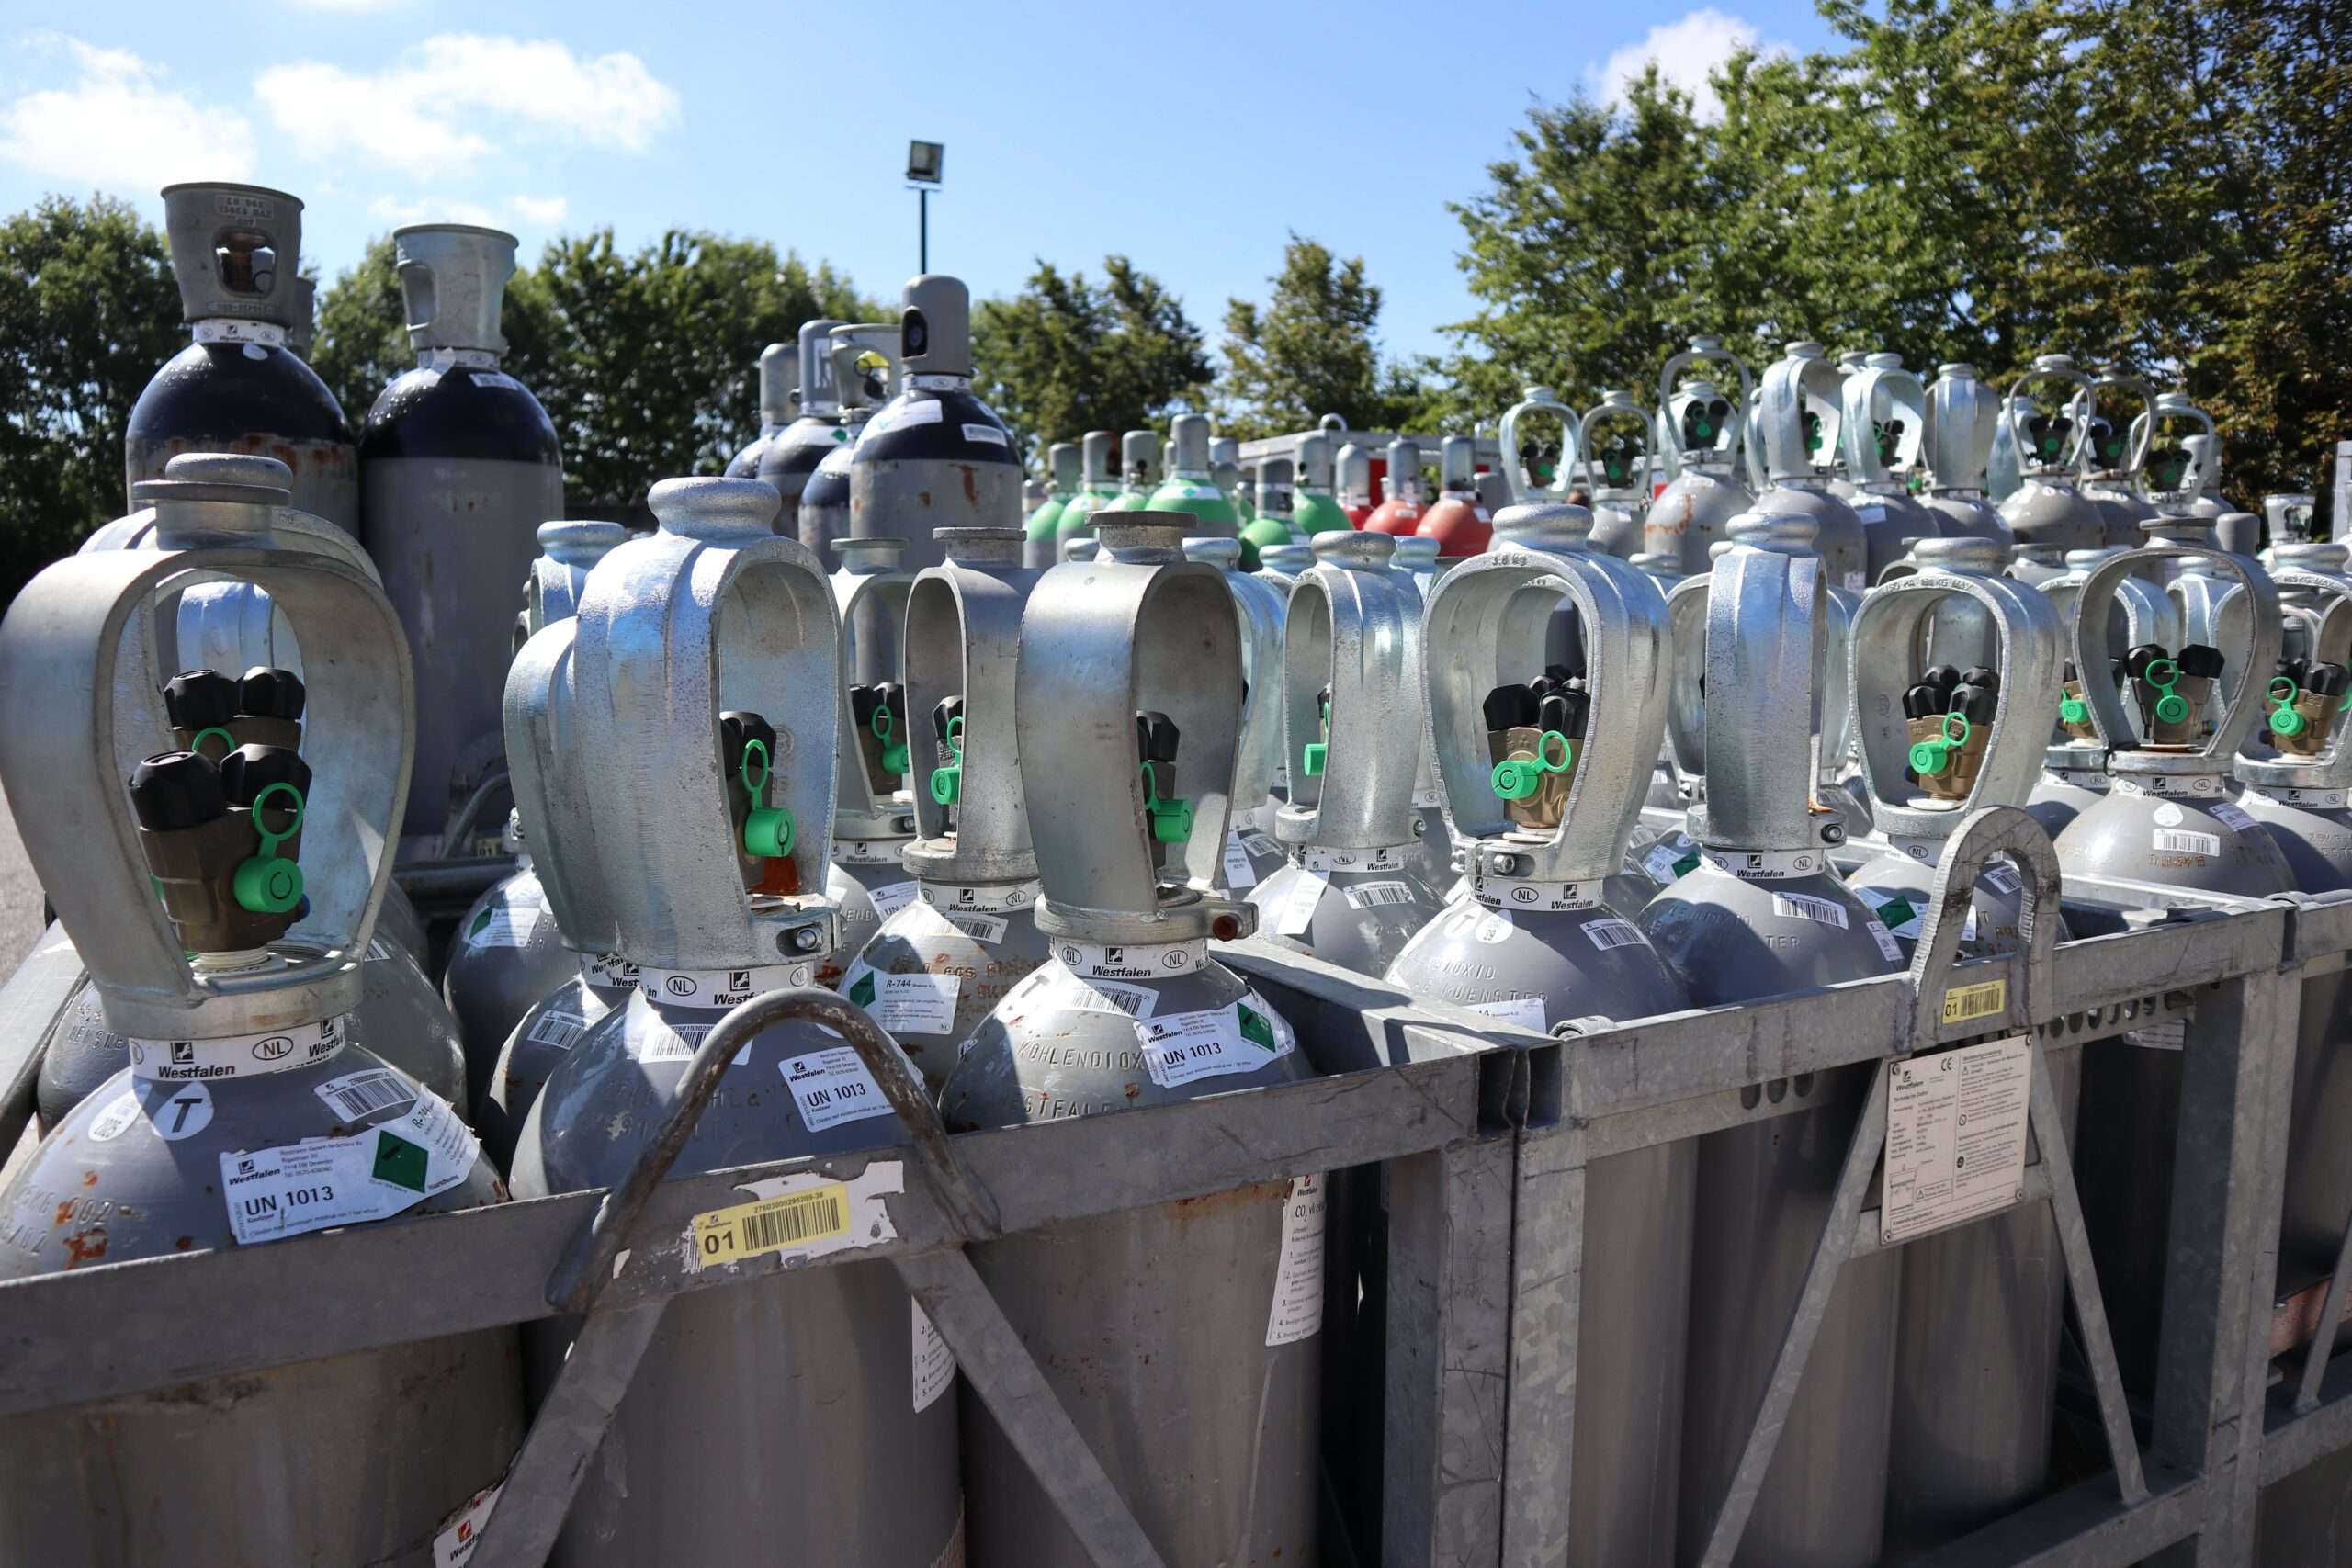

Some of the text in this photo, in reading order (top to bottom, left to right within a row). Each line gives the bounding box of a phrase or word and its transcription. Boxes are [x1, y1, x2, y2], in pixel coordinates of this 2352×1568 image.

[1912, 848, 1923, 856] NL
[1736, 869, 1784, 878] Westfalen
[1476, 895, 1501, 906] stfalen
[1517, 890, 1532, 900] NL
[949, 903, 998, 912] Westfalen
[1551, 899, 1594, 909] Westfalen
[1066, 949, 1078, 964] NL
[1169, 953, 1182, 965] NL
[1092, 965, 1151, 977] Westfalen
[673, 978, 689, 993] NL
[886, 979, 911, 988] R-744
[714, 990, 766, 1005] Westf
[1945, 1003, 1957, 1017] 01
[1148, 1030, 1182, 1043] Westfalen
[263, 1041, 286, 1057] NL
[309, 1034, 344, 1058] Westfa
[1019, 1040, 1146, 1073] KOHLENDIOX
[1163, 1042, 1222, 1065] UN 1013
[158, 1065, 236, 1079] Westfalen
[789, 1068, 826, 1082] Westfalen
[807, 1082, 866, 1107] UN 1013
[171, 1098, 203, 1132] T
[229, 1168, 280, 1186] Westfalen
[245, 1185, 334, 1216] UN 1013
[705, 1230, 735, 1255] 01
